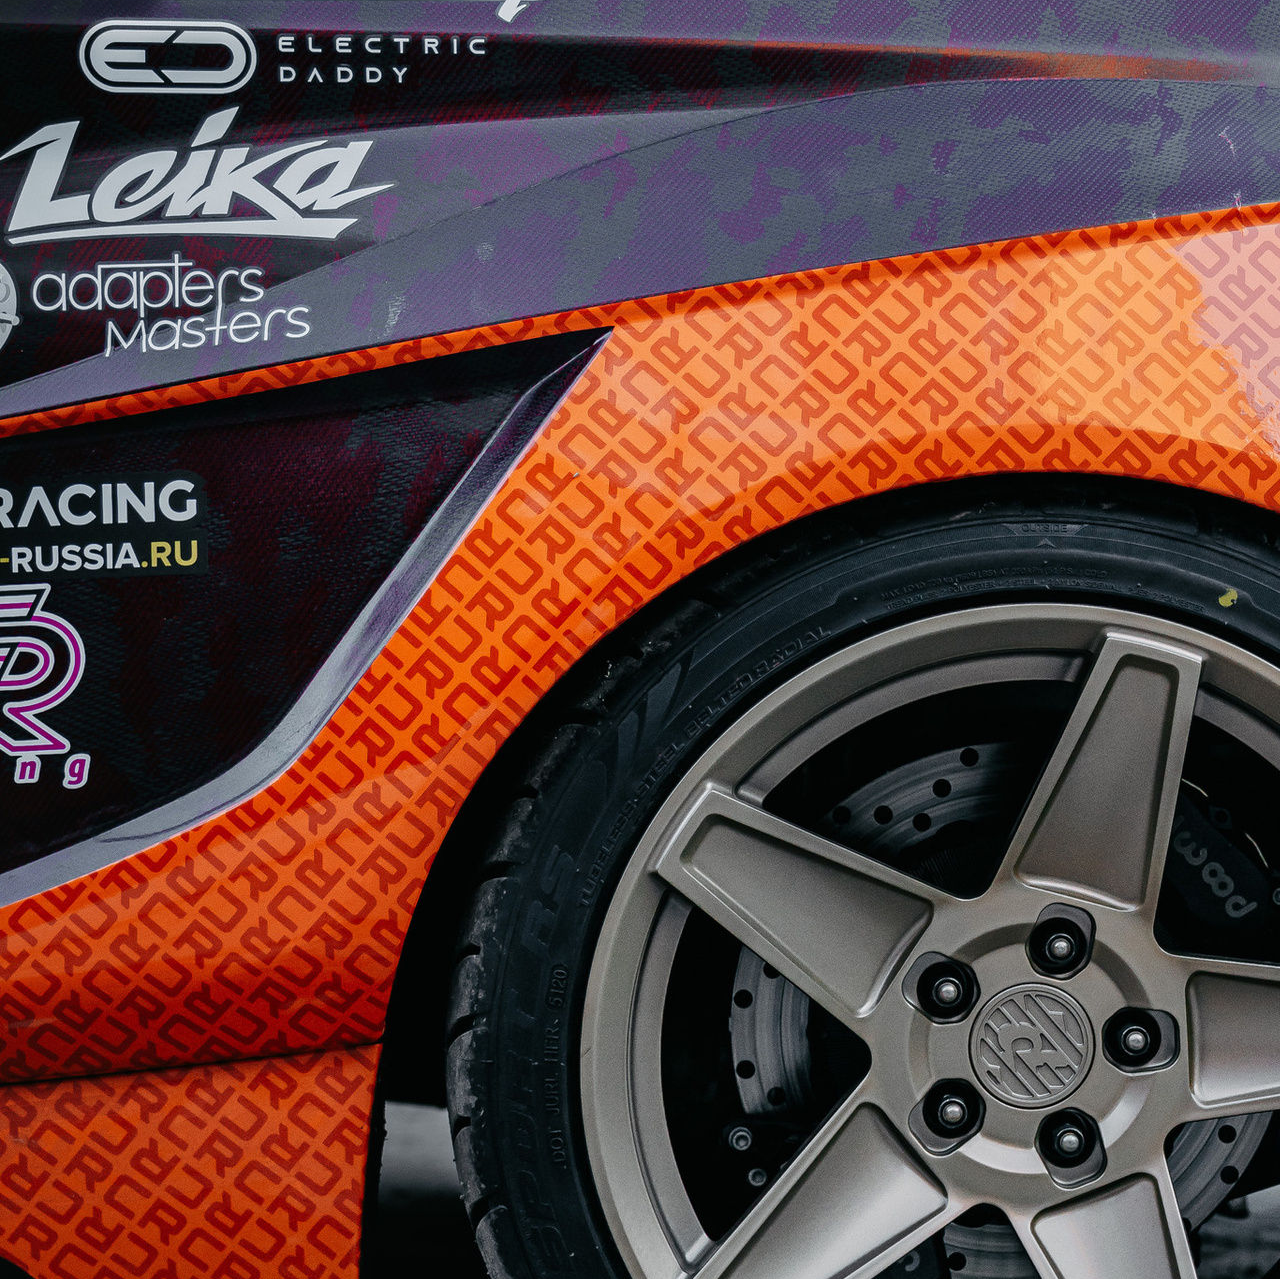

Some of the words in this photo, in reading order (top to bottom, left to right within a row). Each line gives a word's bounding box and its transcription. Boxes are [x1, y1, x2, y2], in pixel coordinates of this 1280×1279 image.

[279, 36, 486, 55] ELECTRIC
[280, 66, 409, 83] DADDY
[0, 106, 394, 233] Leika
[32, 253, 264, 316] adapters
[105, 303, 310, 357] Masters
[546, 967, 568, 1007] 5120
